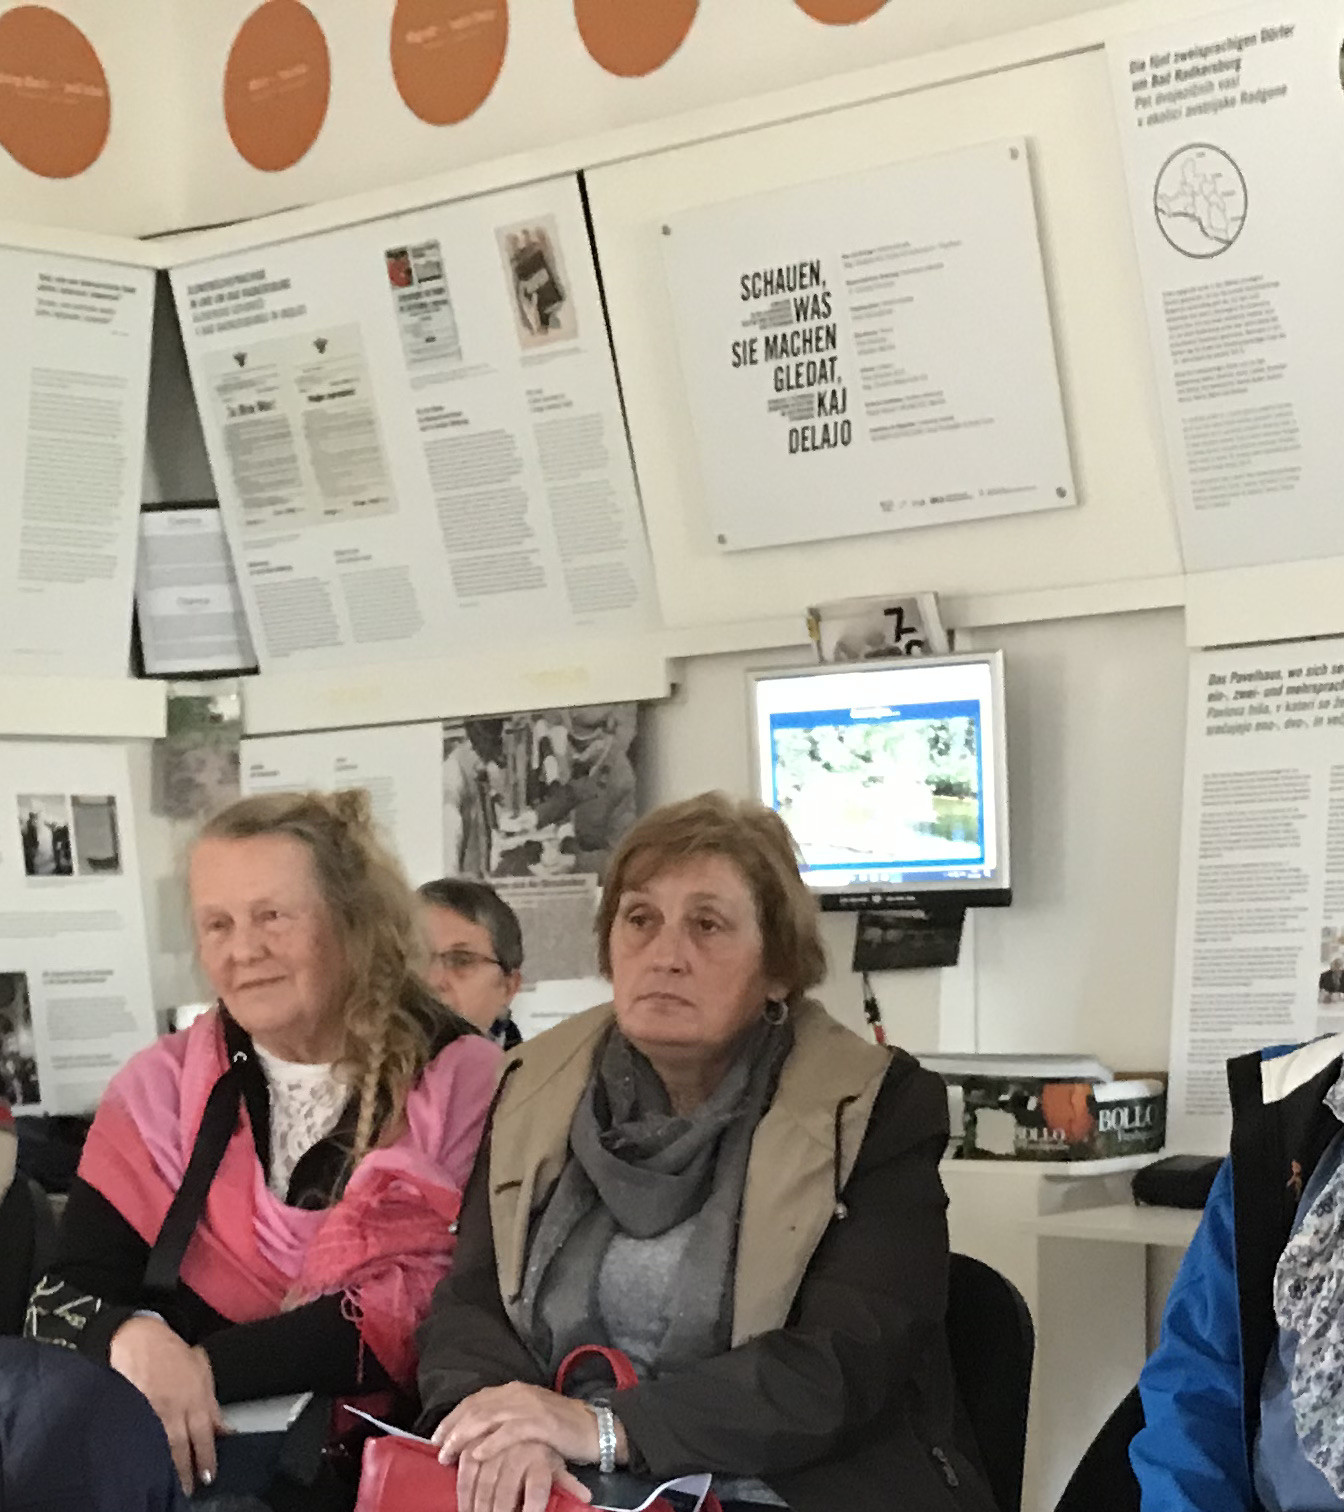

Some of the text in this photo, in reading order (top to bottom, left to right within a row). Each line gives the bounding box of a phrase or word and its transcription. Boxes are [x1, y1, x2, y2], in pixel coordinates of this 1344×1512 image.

[740, 259, 826, 301] SCHAUEN,
[793, 291, 832, 323] WAS
[731, 323, 837, 368] SIE MACHEN
[773, 355, 843, 392] GLEDAT,
[817, 387, 847, 418] KAJ
[788, 419, 852, 454] DELAJO
